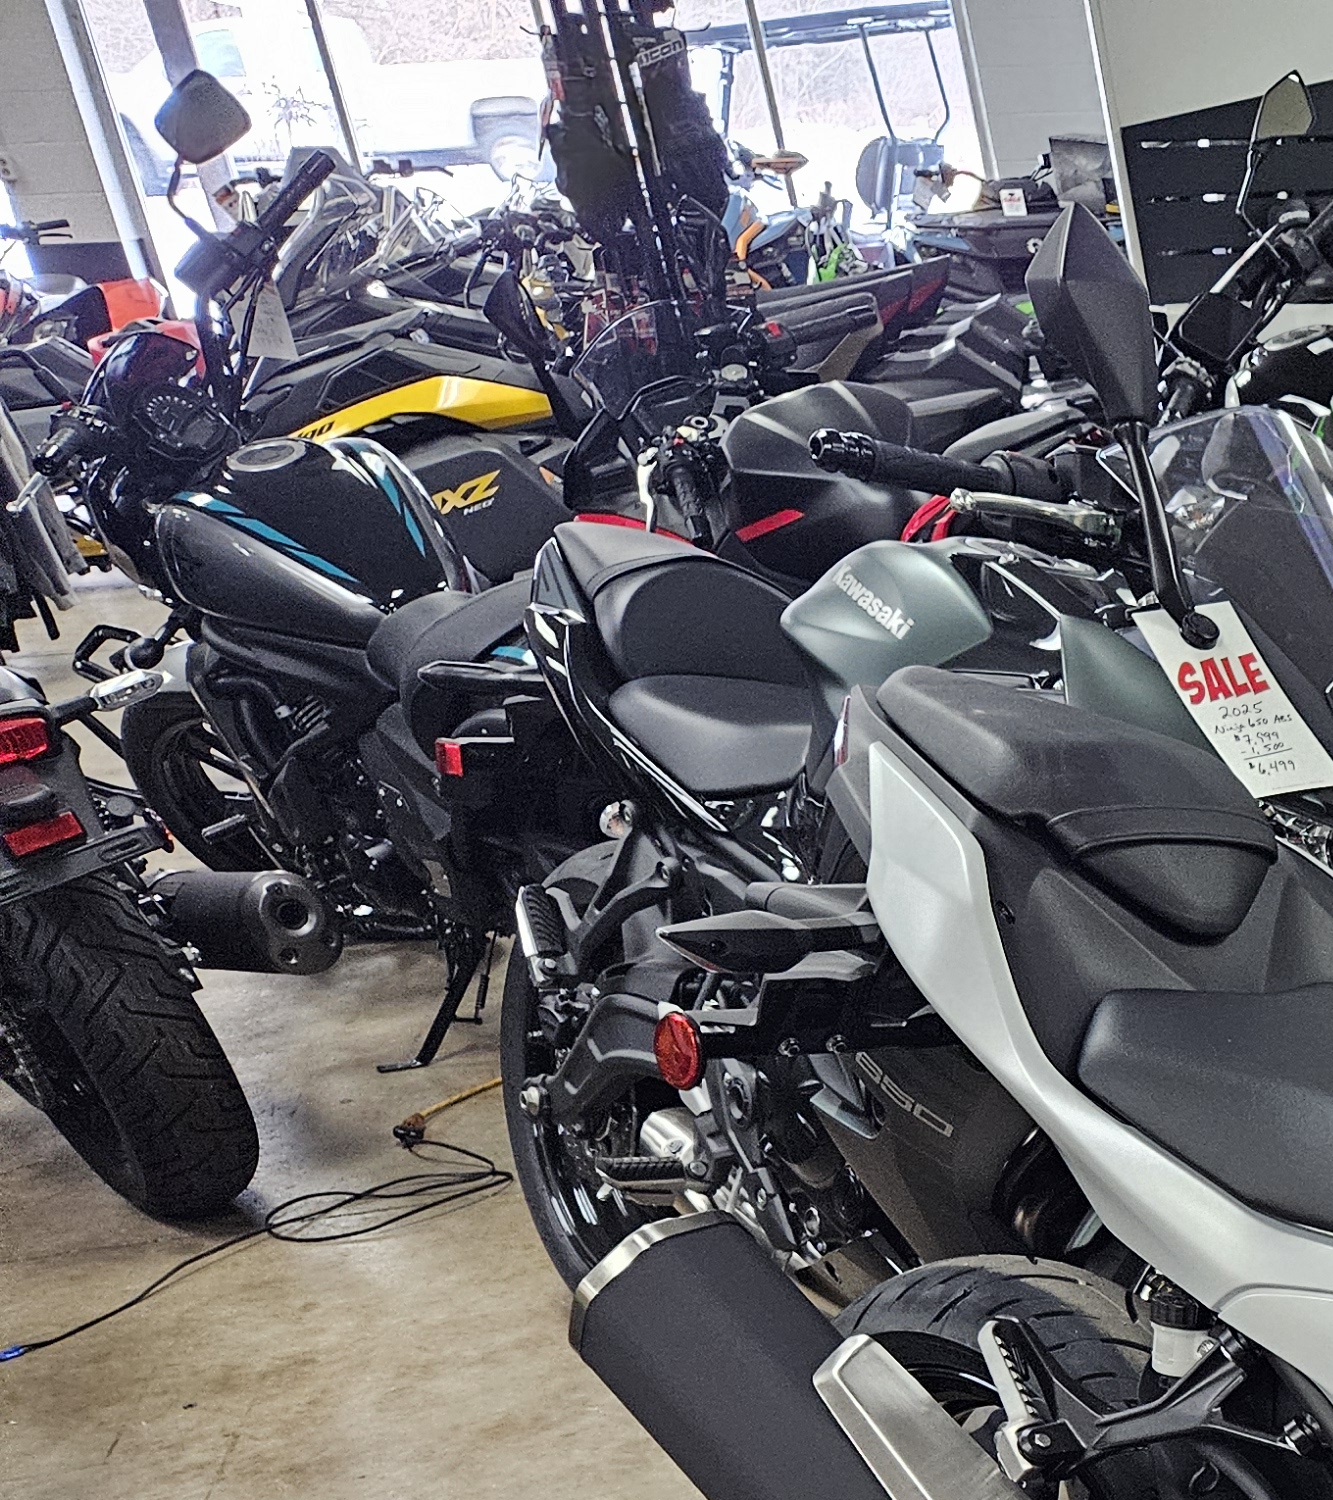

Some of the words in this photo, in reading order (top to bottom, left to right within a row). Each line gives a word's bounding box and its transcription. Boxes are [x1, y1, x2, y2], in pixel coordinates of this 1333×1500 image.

[832, 563, 915, 640] Kawasaki
[1177, 652, 1271, 705] SALE
[1214, 721, 1247, 735] Ninja
[1248, 718, 1269, 728] 650
[1218, 701, 1263, 720] 2025
